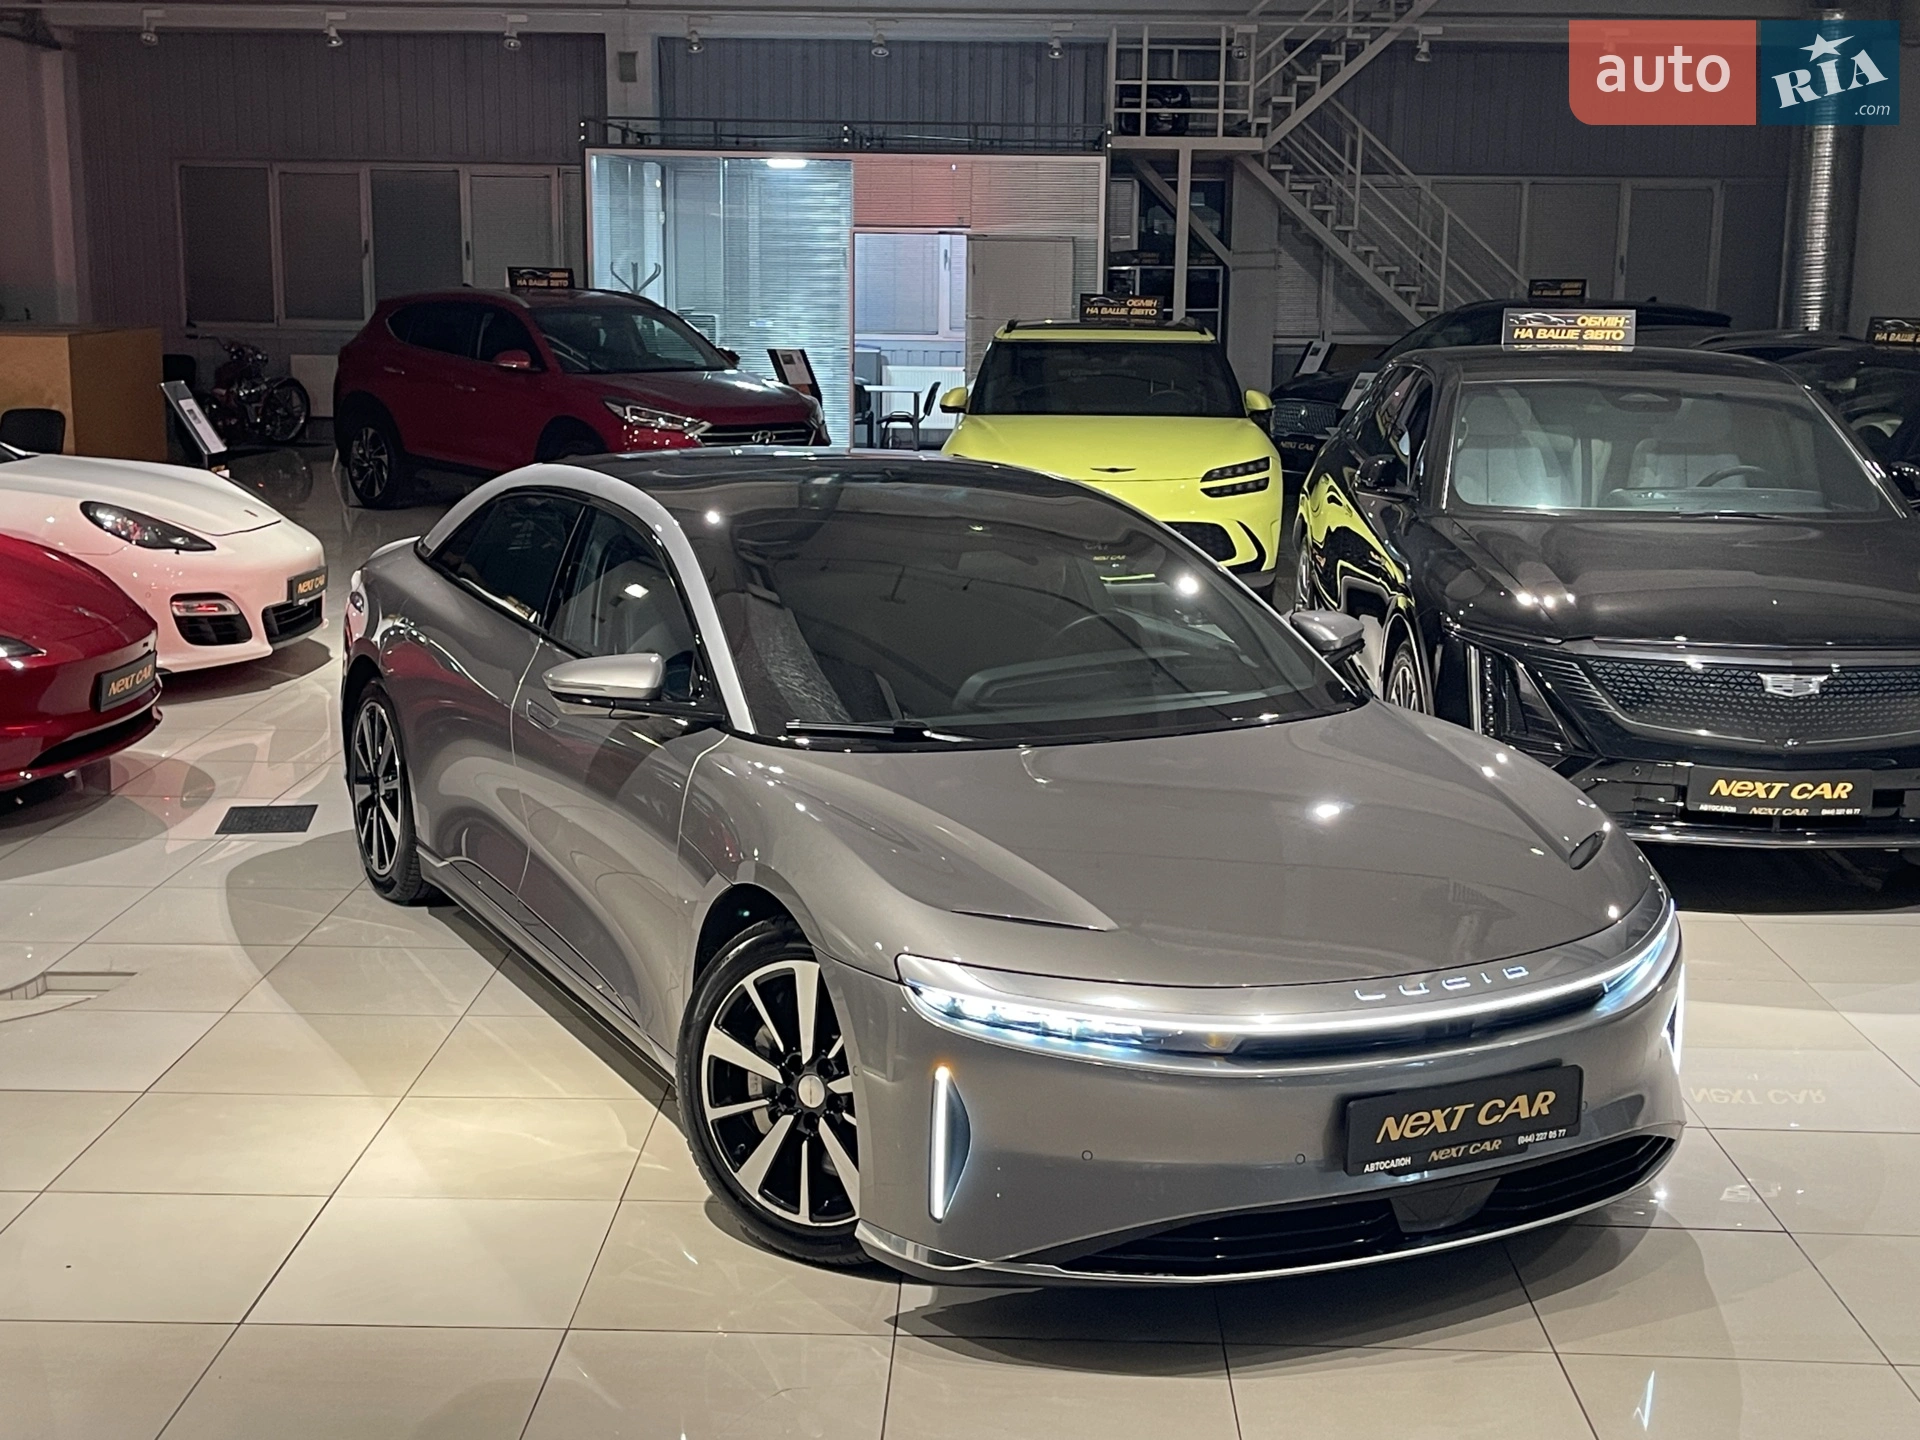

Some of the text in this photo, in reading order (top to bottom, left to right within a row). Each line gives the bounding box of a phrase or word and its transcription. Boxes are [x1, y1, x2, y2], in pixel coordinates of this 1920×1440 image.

[1513, 328, 1534, 339] НА
[1536, 328, 1581, 340] ВАШЕ
[1790, 781, 1854, 800] CAR
[1781, 808, 1810, 816] CAR
[1477, 1090, 1557, 1126] CAR
[1558, 1129, 1567, 1138] 77
[1468, 1138, 1503, 1155] CAR
[1363, 1156, 1412, 1173] АВТОСАЛОН
